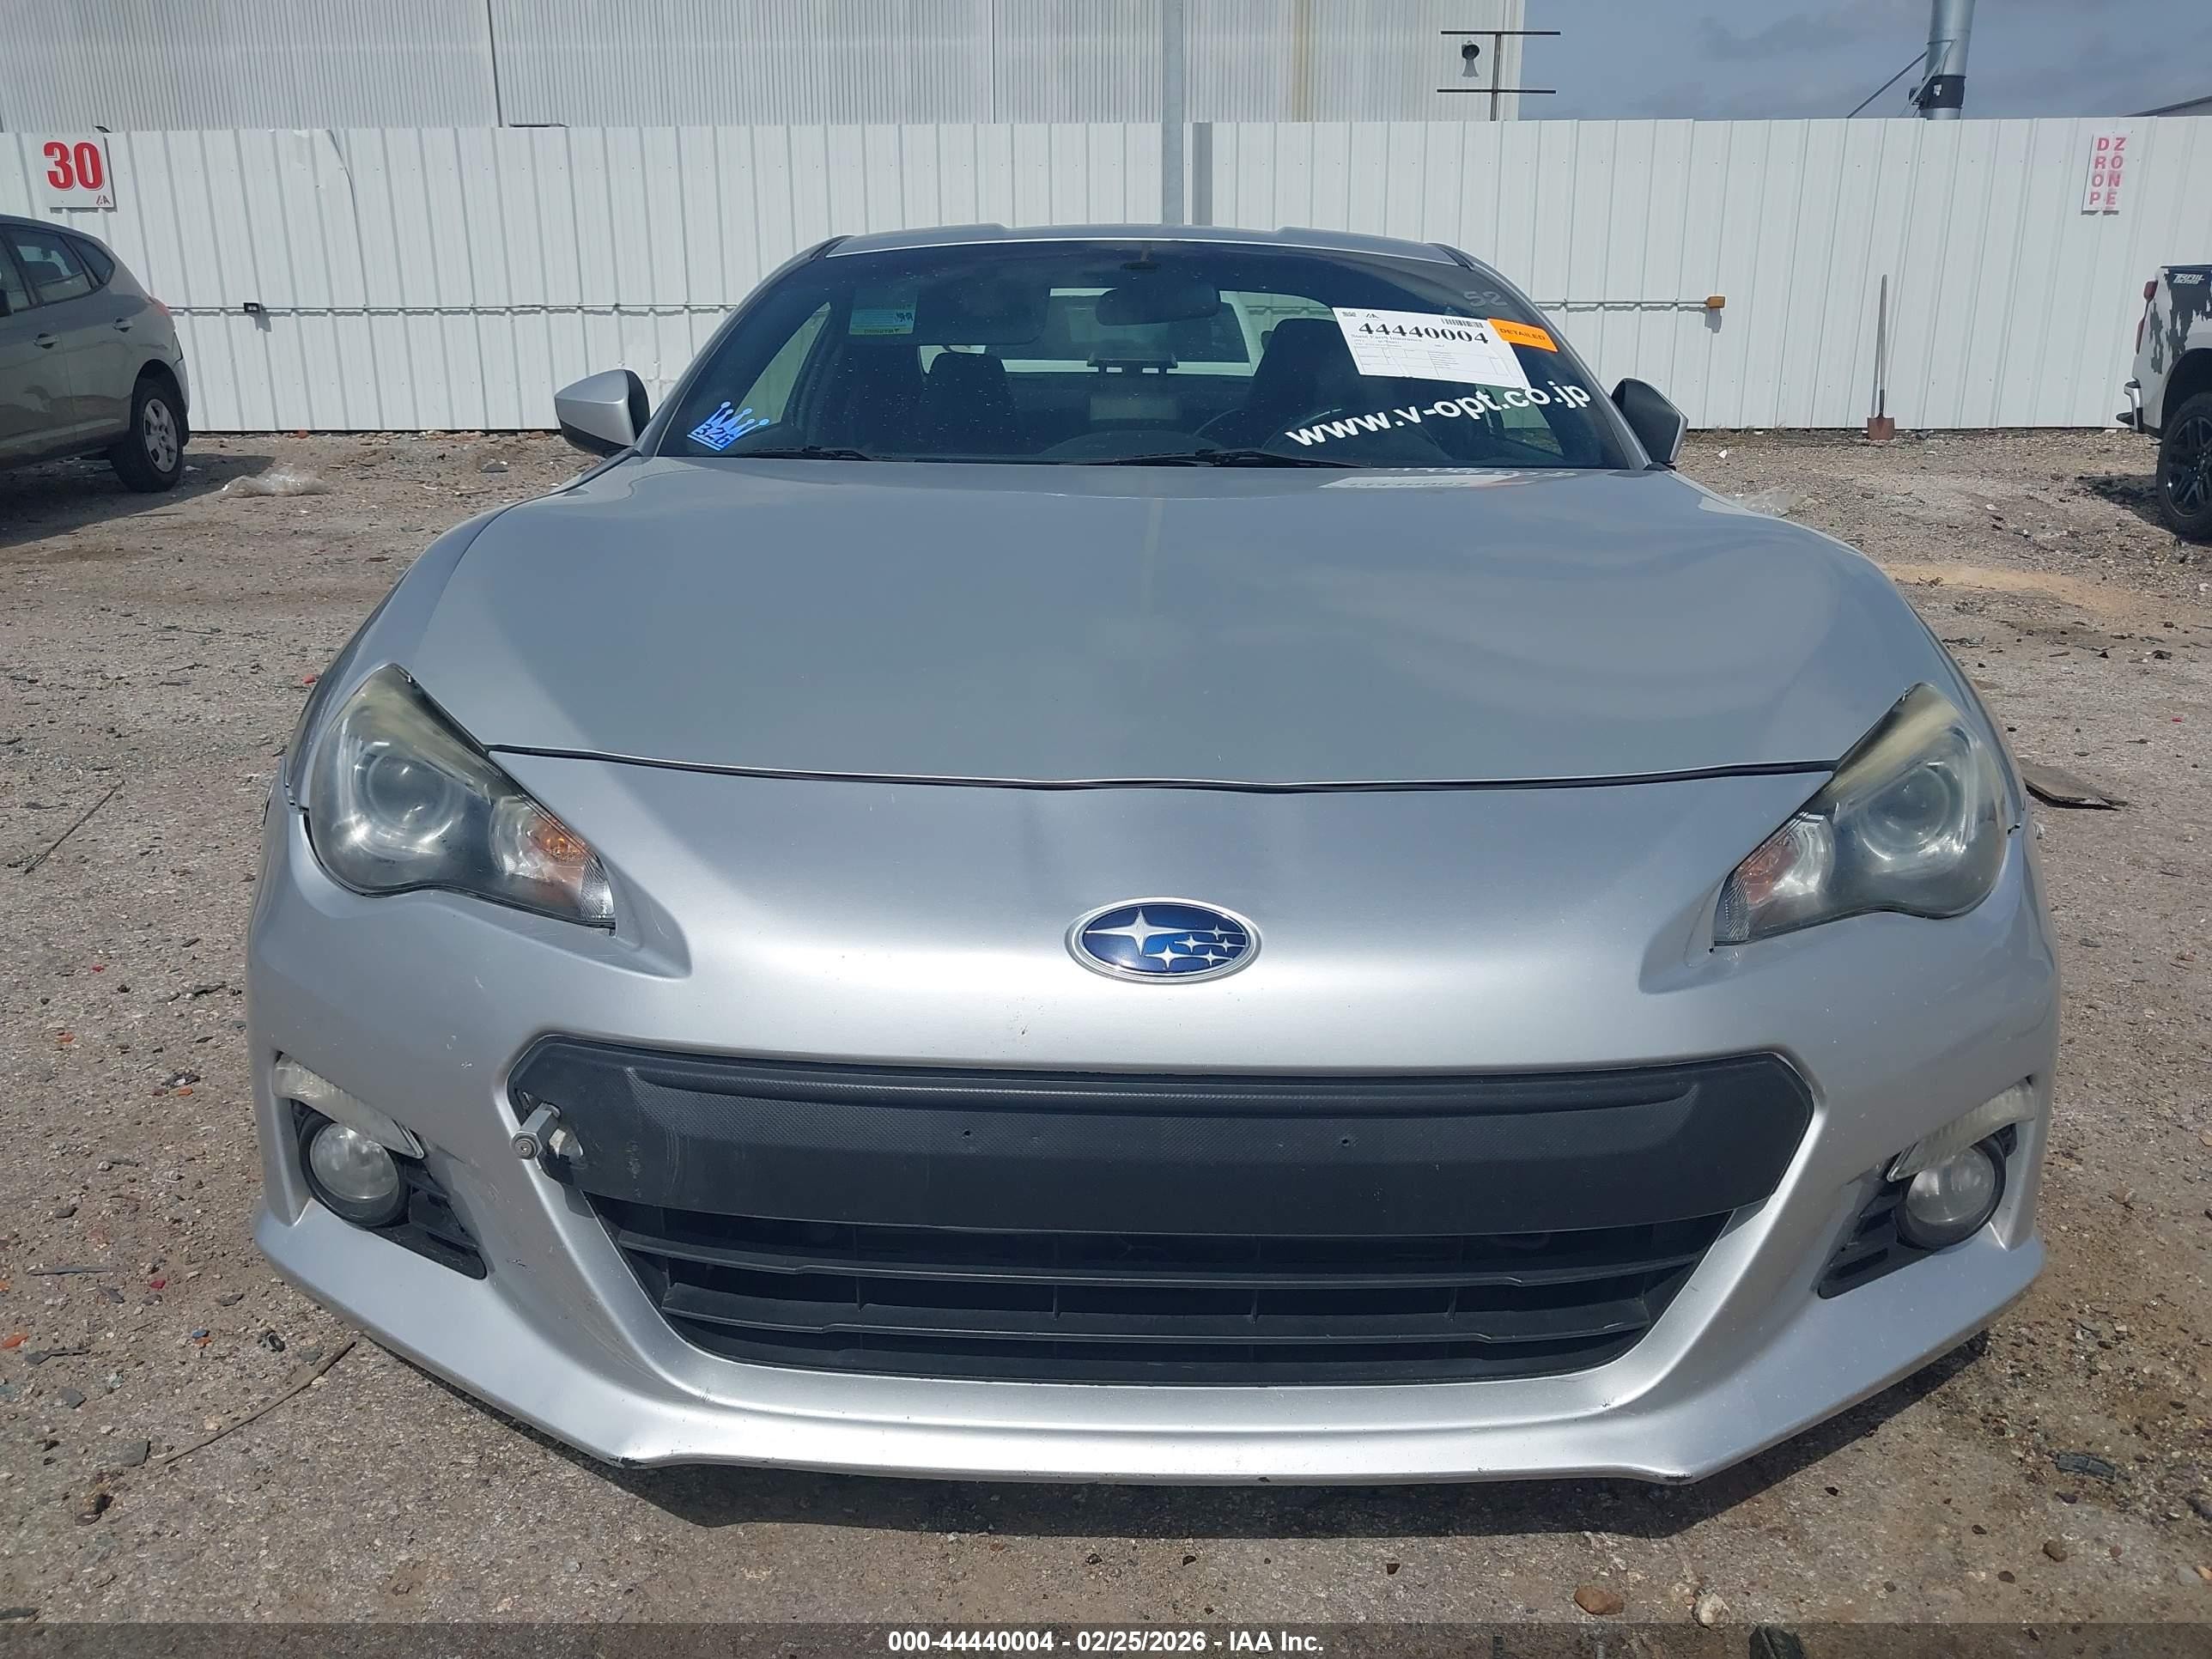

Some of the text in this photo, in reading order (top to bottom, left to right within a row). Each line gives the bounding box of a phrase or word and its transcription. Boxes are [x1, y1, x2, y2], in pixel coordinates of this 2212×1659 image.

[44, 142, 105, 190] 30
[1463, 290, 1508, 307] 52
[1358, 322, 1489, 344] 44440004
[1498, 327, 1547, 341] DETAILED
[1285, 380, 1591, 447] www.v-opt.co.jp
